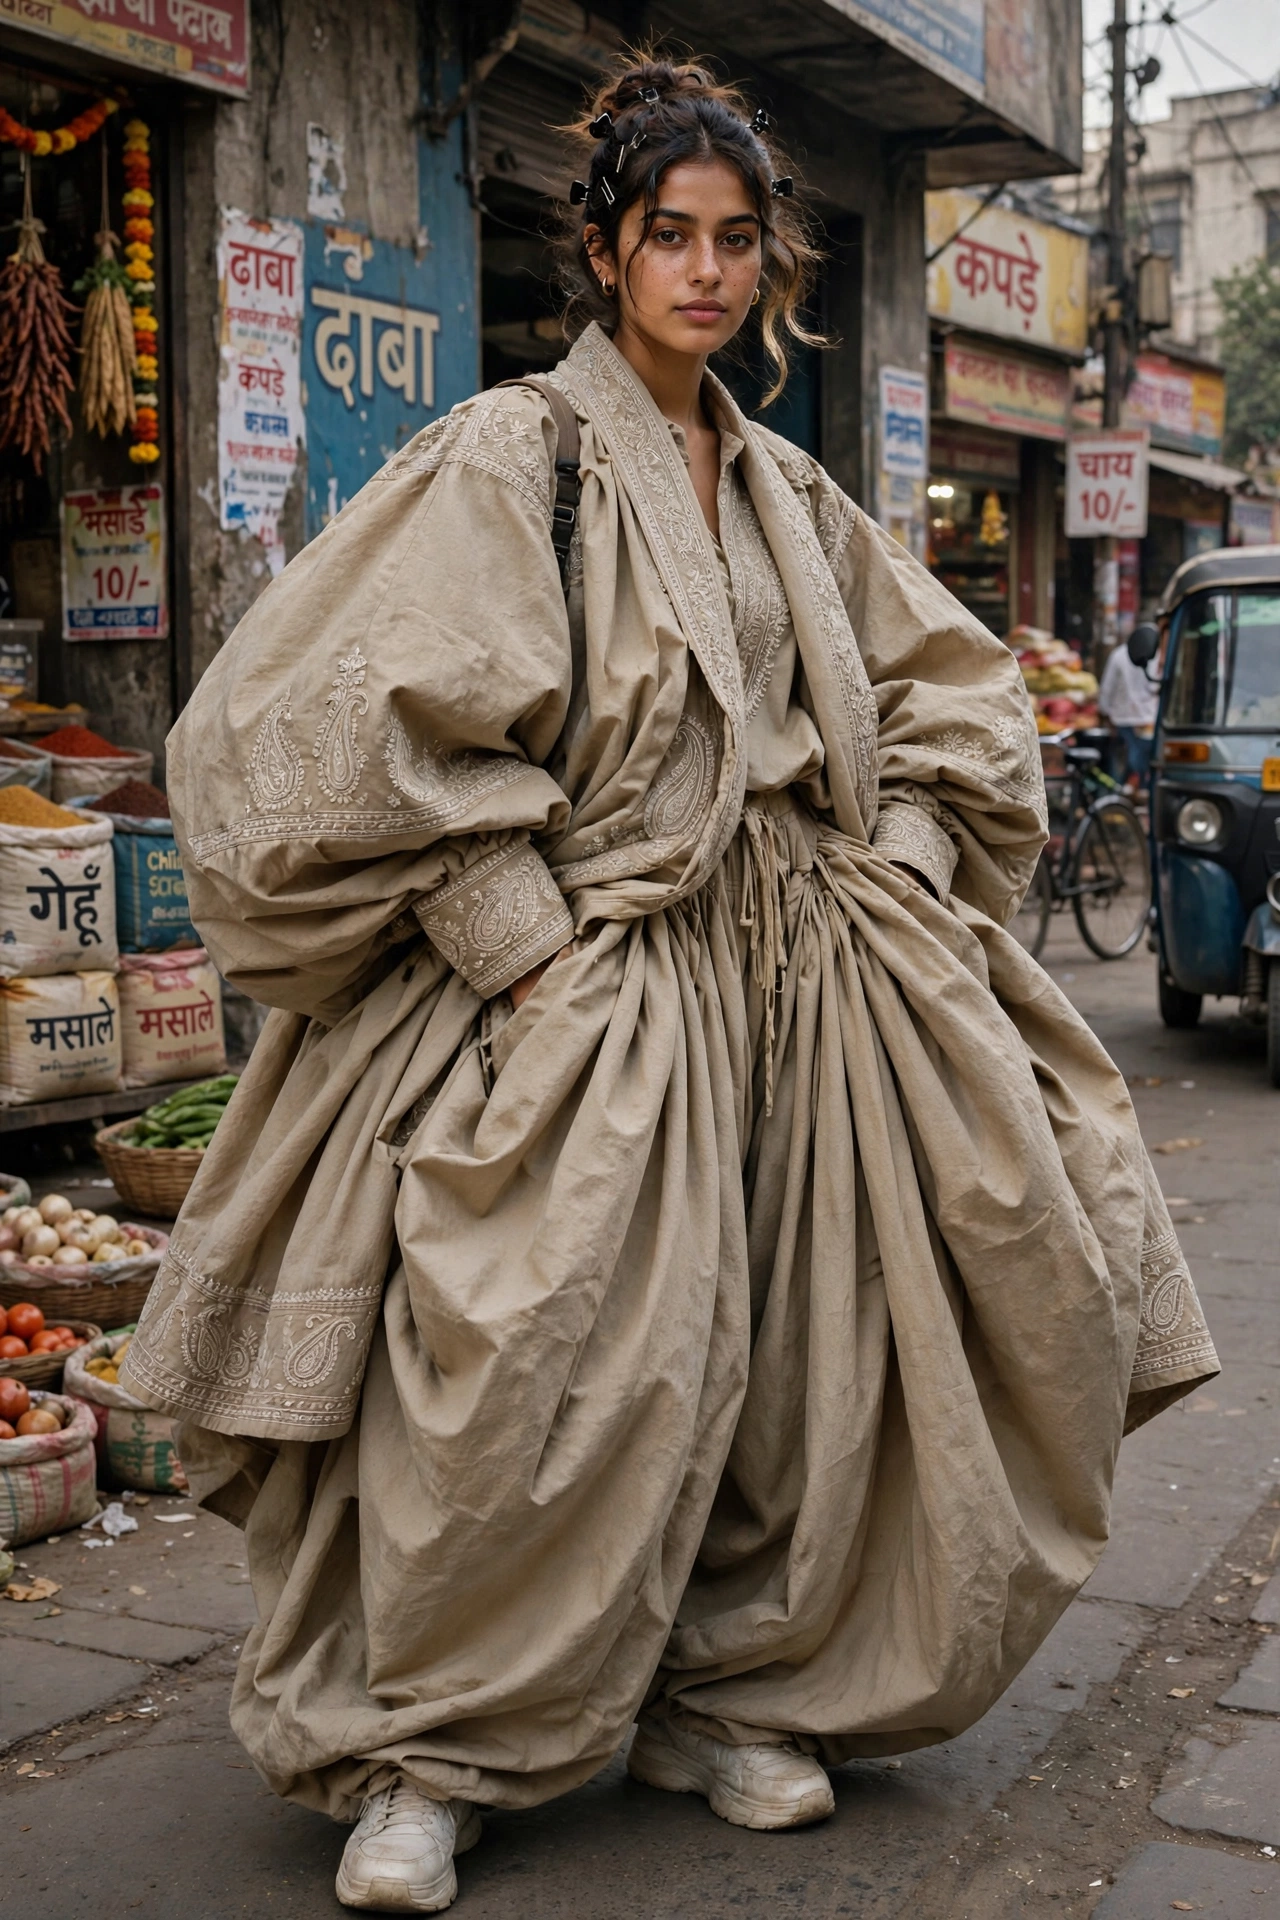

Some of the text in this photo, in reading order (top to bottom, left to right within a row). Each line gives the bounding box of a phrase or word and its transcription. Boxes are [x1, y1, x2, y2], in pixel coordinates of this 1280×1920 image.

[954, 231, 1041, 330] कपड़े
[1077, 452, 1136, 479] चाय
[1079, 489, 1136, 523] 10/-
[92, 565, 150, 601] 10/-
[26, 864, 102, 947] गेहूँ
[26, 997, 115, 1050] मसाले
[136, 990, 215, 1039] मसाले
